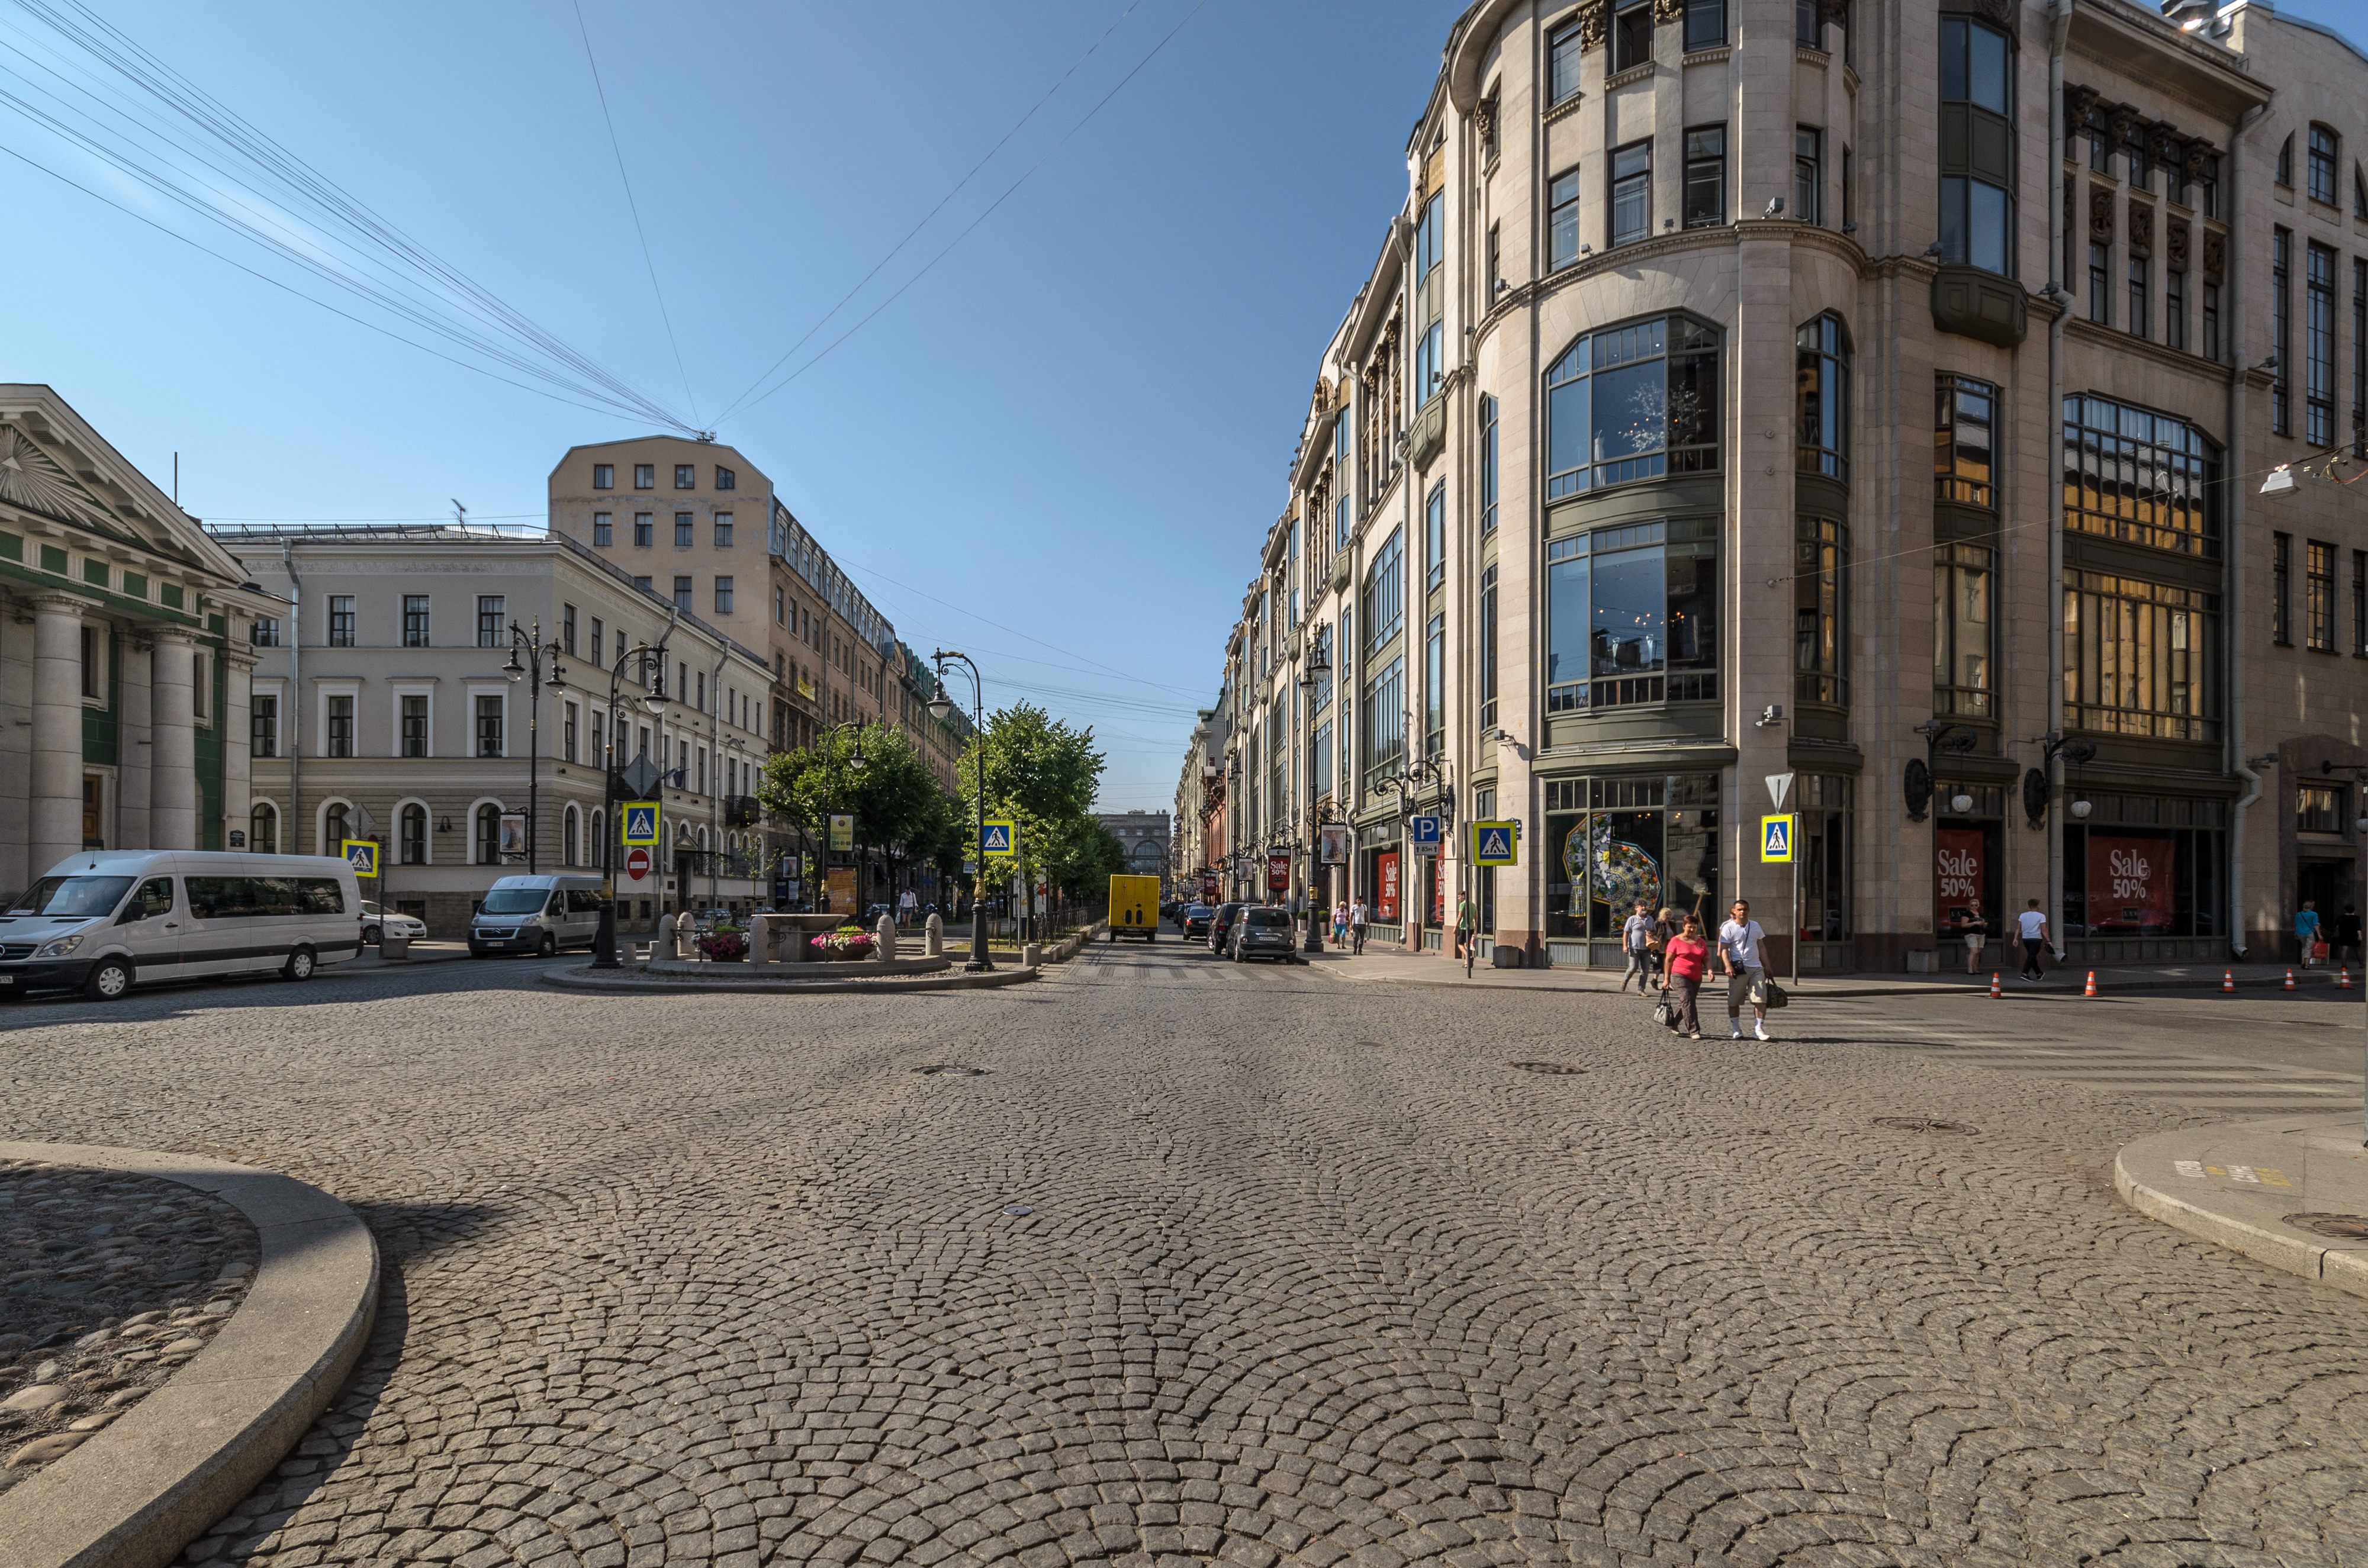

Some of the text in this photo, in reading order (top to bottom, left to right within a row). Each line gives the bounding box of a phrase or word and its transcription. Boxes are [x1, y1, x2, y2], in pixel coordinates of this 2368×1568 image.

[1420, 820, 1434, 839] P
[1270, 861, 1288, 870] Sale
[1385, 861, 1397, 882] Sale
[1938, 849, 1977, 876] Sale
[2110, 849, 2148, 877] Sale
[1385, 883, 1395, 897] 50%
[1941, 878, 1975, 897] 50%
[2113, 878, 2146, 899] 50%
